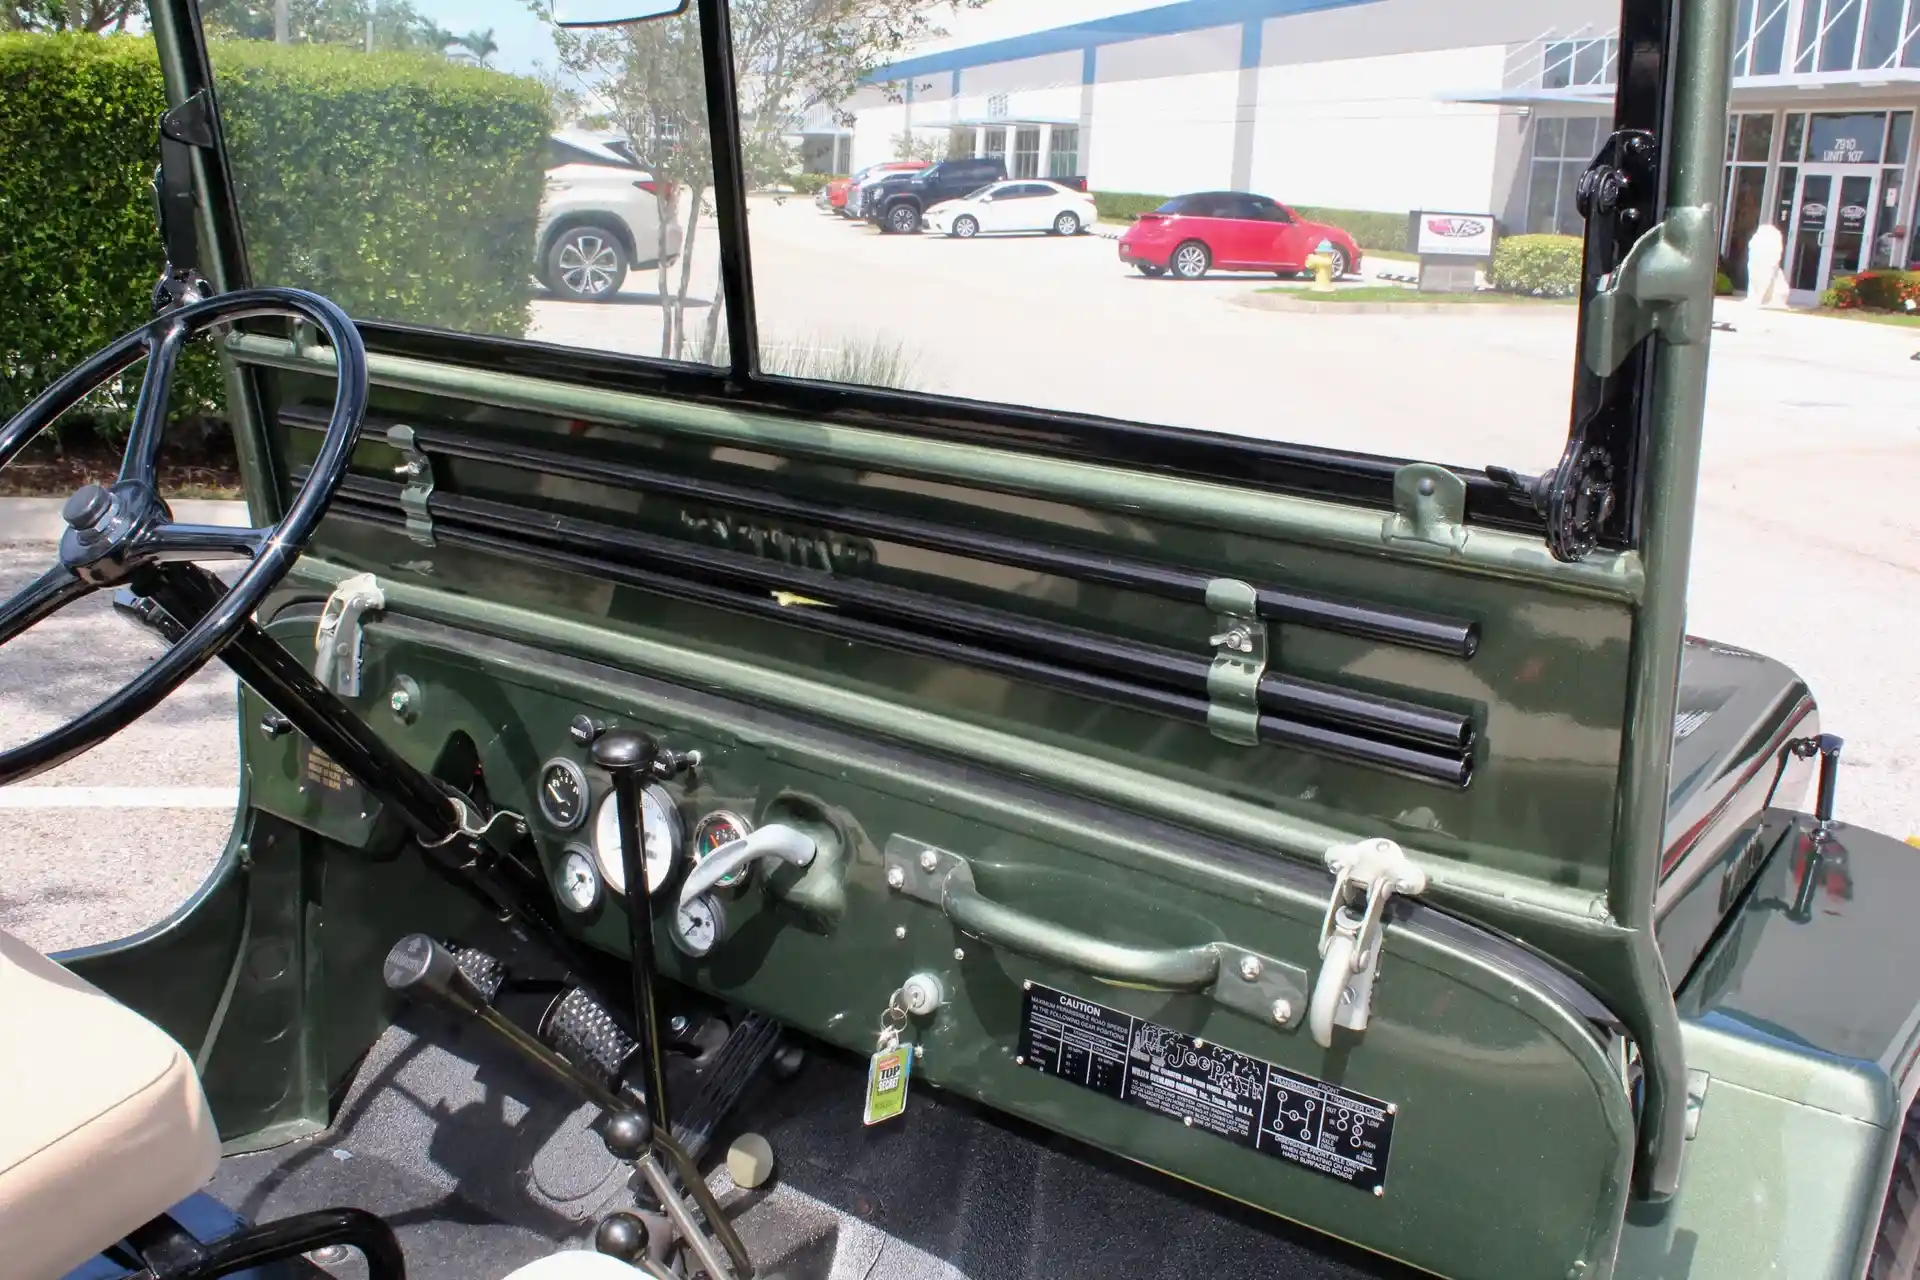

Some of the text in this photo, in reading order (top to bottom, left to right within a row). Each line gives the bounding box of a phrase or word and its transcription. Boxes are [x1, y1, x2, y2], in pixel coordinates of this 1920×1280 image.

[1835, 138, 1857, 149] 7910
[1823, 150, 1864, 162] UNIT 107
[1059, 995, 1101, 1017] CAUTION
[1031, 996, 1128, 1034] MAXIMUM PERMISSIBLE ROAD SPEEDS
[1039, 1006, 1049, 1014] THE
[1049, 1010, 1079, 1025] FOLLOWING
[1080, 1021, 1095, 1030] GEAR
[1096, 1026, 1124, 1040] POSITIONS
[1168, 1042, 1226, 1085] Jeep
[881, 1064, 900, 1079] TOP
[1273, 1076, 1320, 1097] TRANSMISSION
[1317, 1082, 1339, 1095] FRONT
[1144, 1089, 1164, 1100] LOCATED
[1226, 1118, 1237, 1126] LEFT
[1154, 1087, 1175, 1098] COOLING
[1176, 1095, 1194, 1105] SYSTEM
[1196, 1102, 1209, 1110] OPEN
[1211, 1107, 1233, 1119] RADIATOR
[1325, 1106, 1336, 1114] OUT
[1330, 1095, 1383, 1119] TRANSFER CASE
[1137, 1092, 1159, 1104] RADIATOR
[1171, 1104, 1193, 1116] CYLINDER
[1194, 1112, 1210, 1122] BLOCK
[1226, 1124, 1239, 1132] COCK
[1160, 1105, 1182, 1117] FORWARD
[1366, 1119, 1379, 1128] LOW
[1321, 1137, 1334, 1146] AXLE
[1322, 1131, 1338, 1142] FRONT
[1320, 1142, 1335, 1152] DRIVE
[1362, 1140, 1375, 1149] HIGH
[1274, 1135, 1363, 1171] DISENGAGE FRONT AXLE DRIVE
[1280, 1144, 1297, 1154] WHEN
[1298, 1150, 1332, 1166] OPERATING
[1343, 1166, 1355, 1175] DRY
[1355, 1154, 1373, 1165] RANGE
[1361, 1150, 1372, 1158] AUX
[1282, 1150, 1352, 1180] HARD SURFACED ROADS
